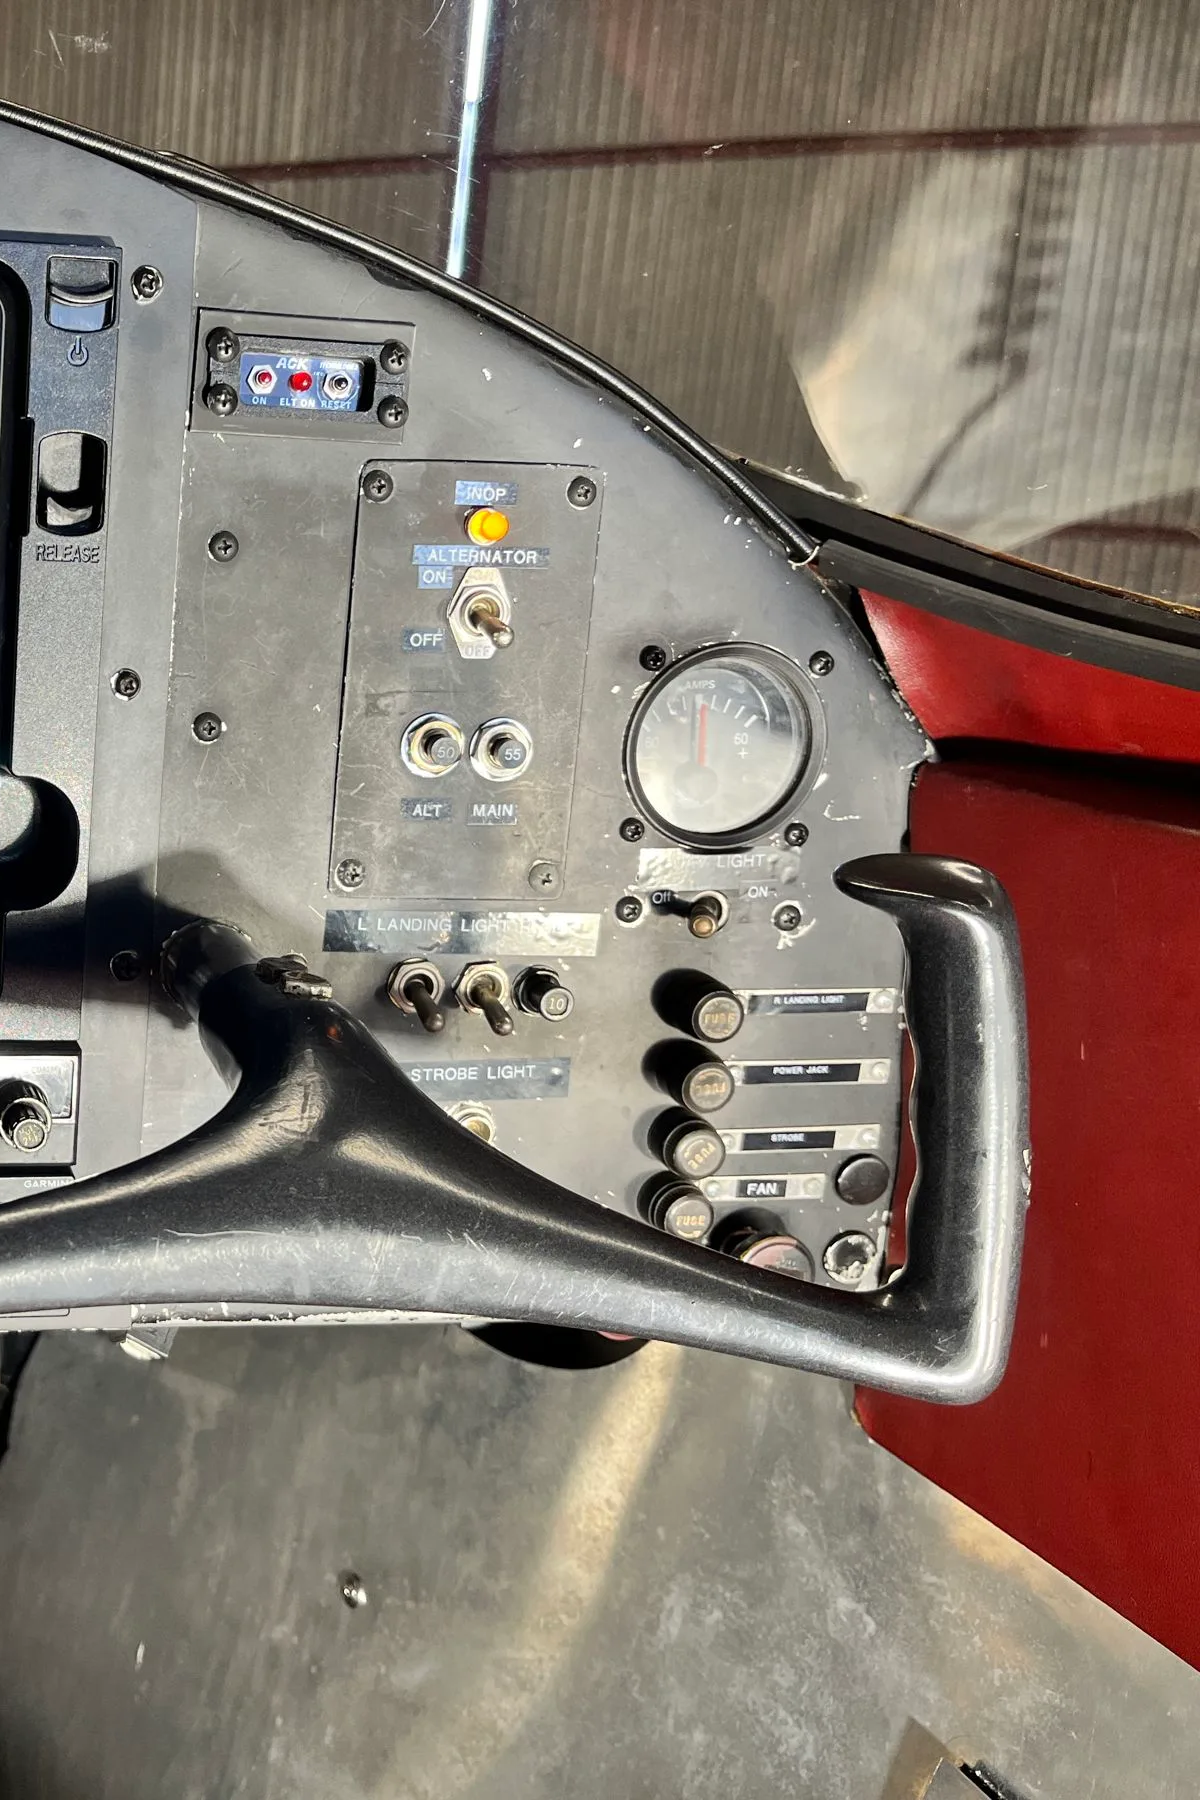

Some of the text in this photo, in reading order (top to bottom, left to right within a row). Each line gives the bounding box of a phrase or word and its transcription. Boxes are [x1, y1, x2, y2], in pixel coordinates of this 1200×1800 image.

[276, 357, 308, 370] ACK
[252, 396, 266, 405] ON
[280, 397, 316, 408] ELT ON
[320, 400, 352, 410] RESET
[466, 487, 506, 502] INOP
[36, 545, 100, 562] RELEASE
[428, 549, 538, 565] ALTERNATOR
[422, 570, 446, 584] ON
[409, 632, 443, 647] OFF
[464, 644, 491, 658] OFF
[685, 680, 716, 690] AMPS
[734, 733, 749, 746] 60
[436, 746, 455, 759] 50
[504, 748, 521, 761] 55
[412, 804, 443, 817] ALT
[472, 803, 514, 818] MAIN
[716, 854, 767, 869] LIGHT
[652, 891, 672, 905] Off
[747, 886, 769, 899] ON
[358, 917, 367, 931] L
[377, 918, 451, 932] LANDING
[461, 918, 511, 932] LIGHT
[549, 998, 564, 1010] 10
[773, 994, 846, 1005] R LANDING LIGHT
[704, 1012, 736, 1025] FUSE
[411, 1065, 536, 1082] STROBE LIGHT
[772, 1065, 829, 1075] POWER JACK
[770, 1133, 804, 1143] STROBE
[747, 1183, 778, 1196] FAN
[675, 1215, 706, 1227] FUSE
